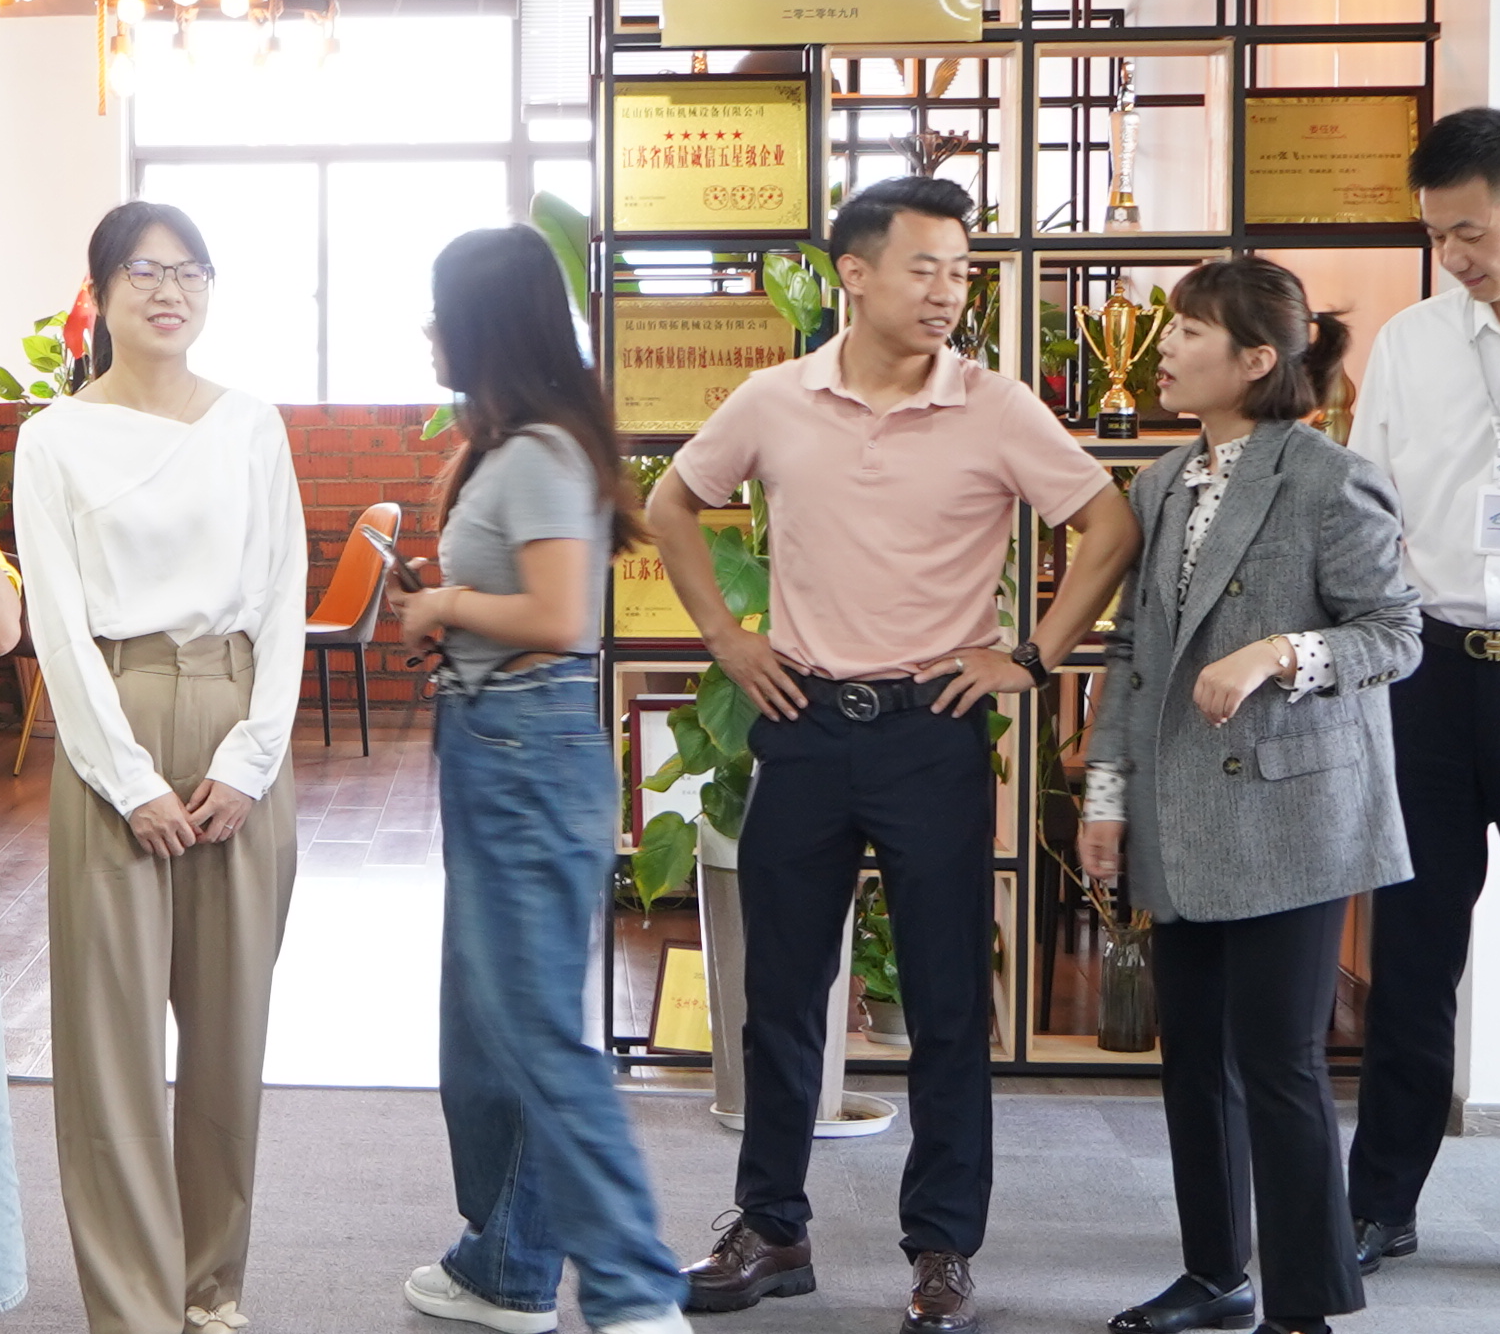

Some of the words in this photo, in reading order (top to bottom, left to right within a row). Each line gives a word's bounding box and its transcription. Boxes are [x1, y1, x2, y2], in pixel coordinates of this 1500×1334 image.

[782, 8, 859, 20] 二零二零年九月
[623, 144, 785, 169] 江苏省质量诚信五星级企业
[622, 557, 665, 581] 江苏省
